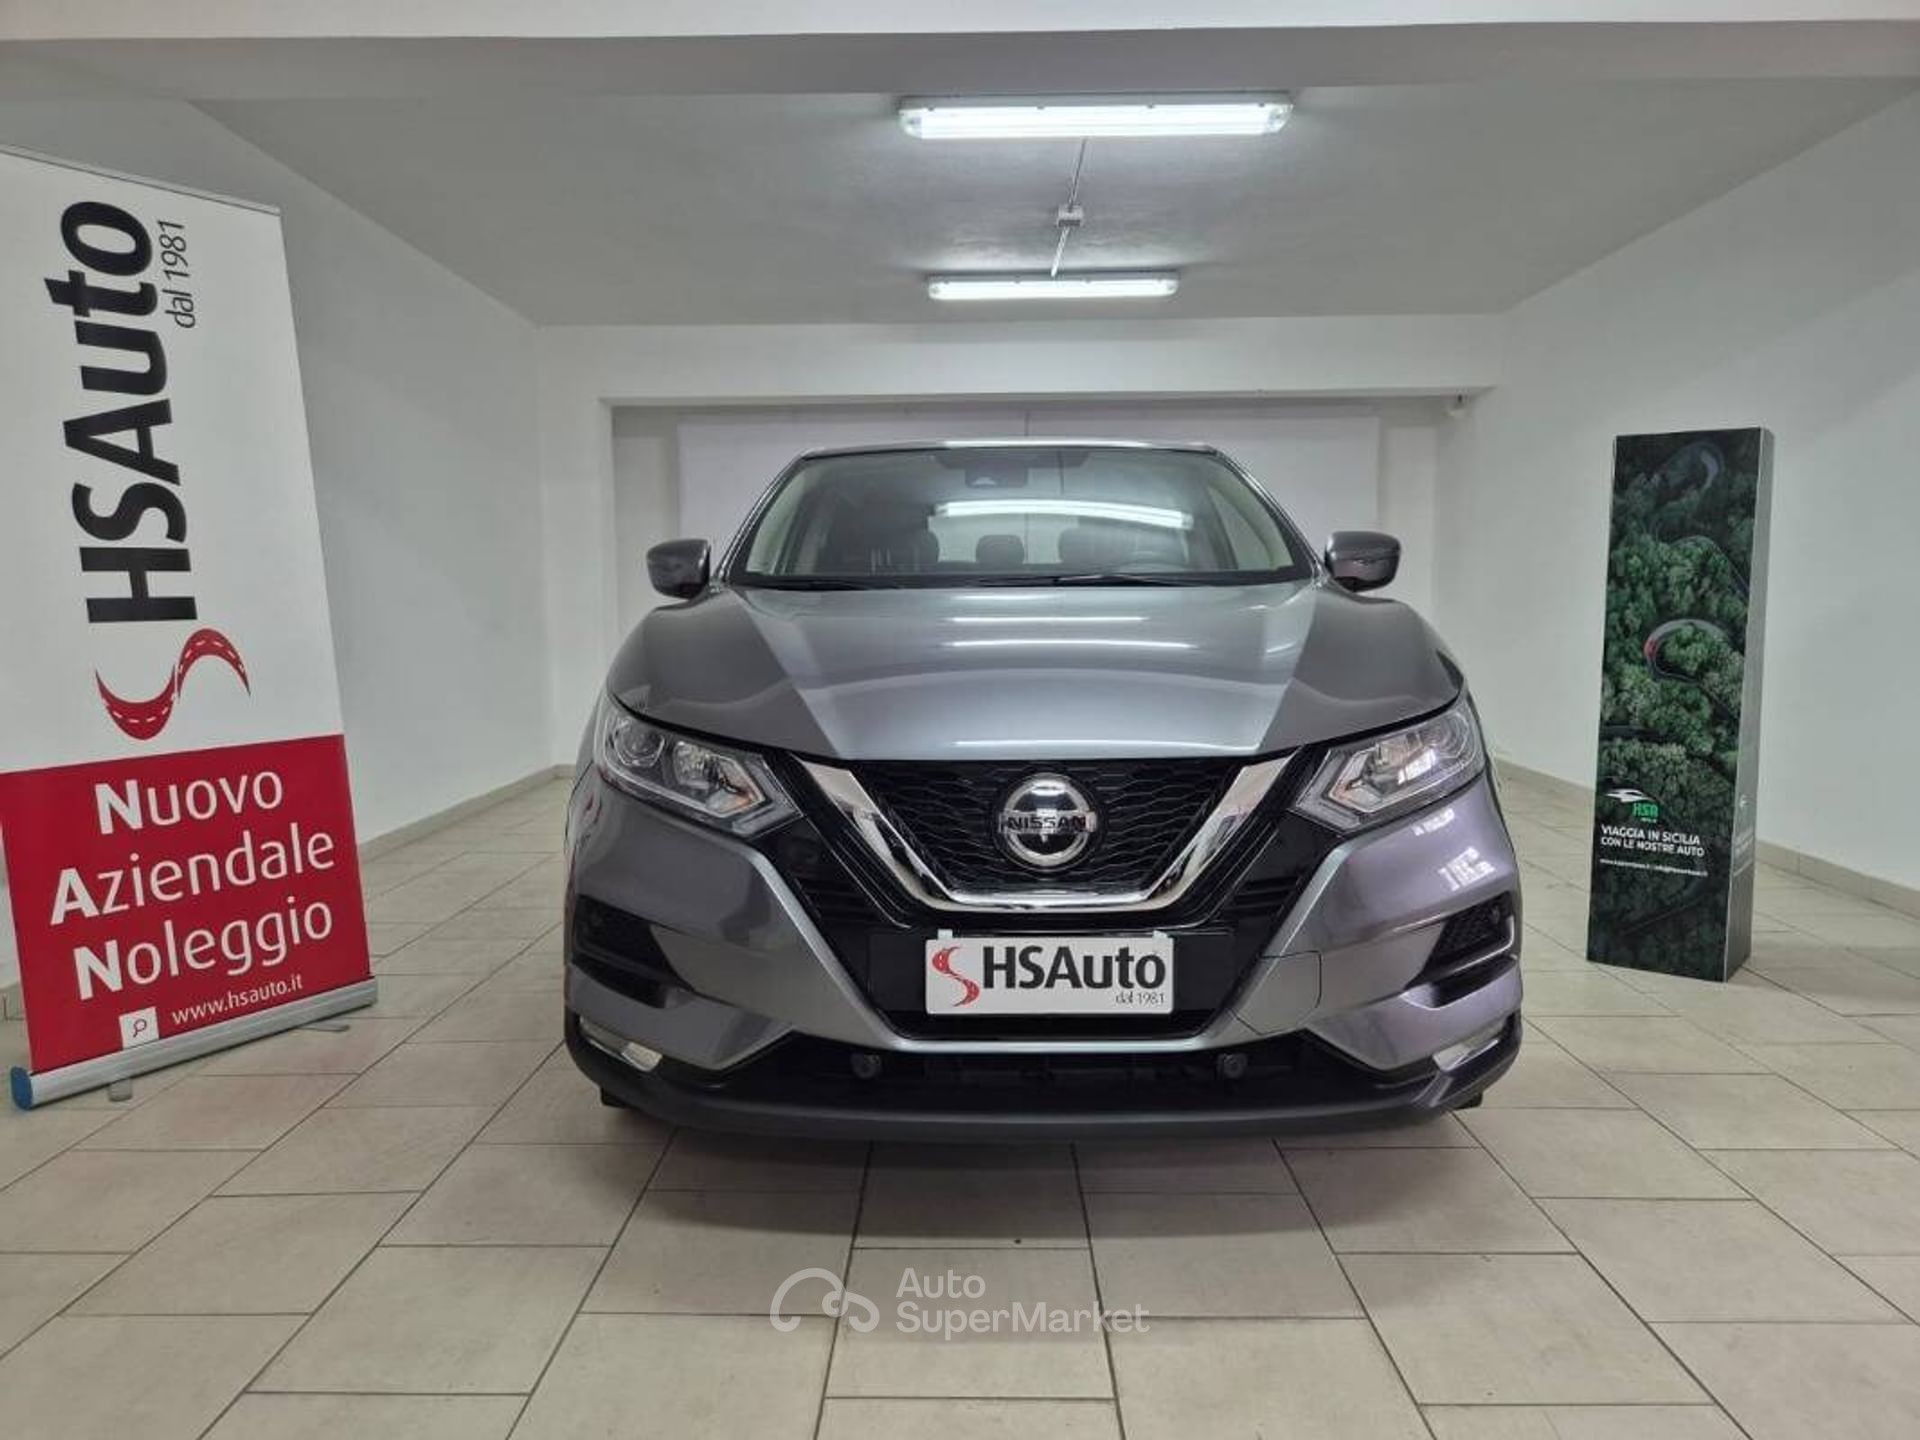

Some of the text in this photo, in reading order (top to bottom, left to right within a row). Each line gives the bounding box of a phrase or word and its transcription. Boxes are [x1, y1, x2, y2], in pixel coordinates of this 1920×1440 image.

[157, 219, 196, 329] dal 1981
[43, 201, 198, 623] HSAuto
[95, 771, 283, 834] Nuovo
[1008, 816, 1086, 831] NISSAN
[1601, 824, 1701, 845] VIAGGIA IN SICILIA
[1601, 837, 1705, 857] CON LE NOSTRE AUTO
[50, 822, 334, 925] Aziendale
[73, 895, 332, 1000] Noleggio
[983, 946, 1166, 989] HSAuto
[172, 973, 303, 1025] www.hsauto.it
